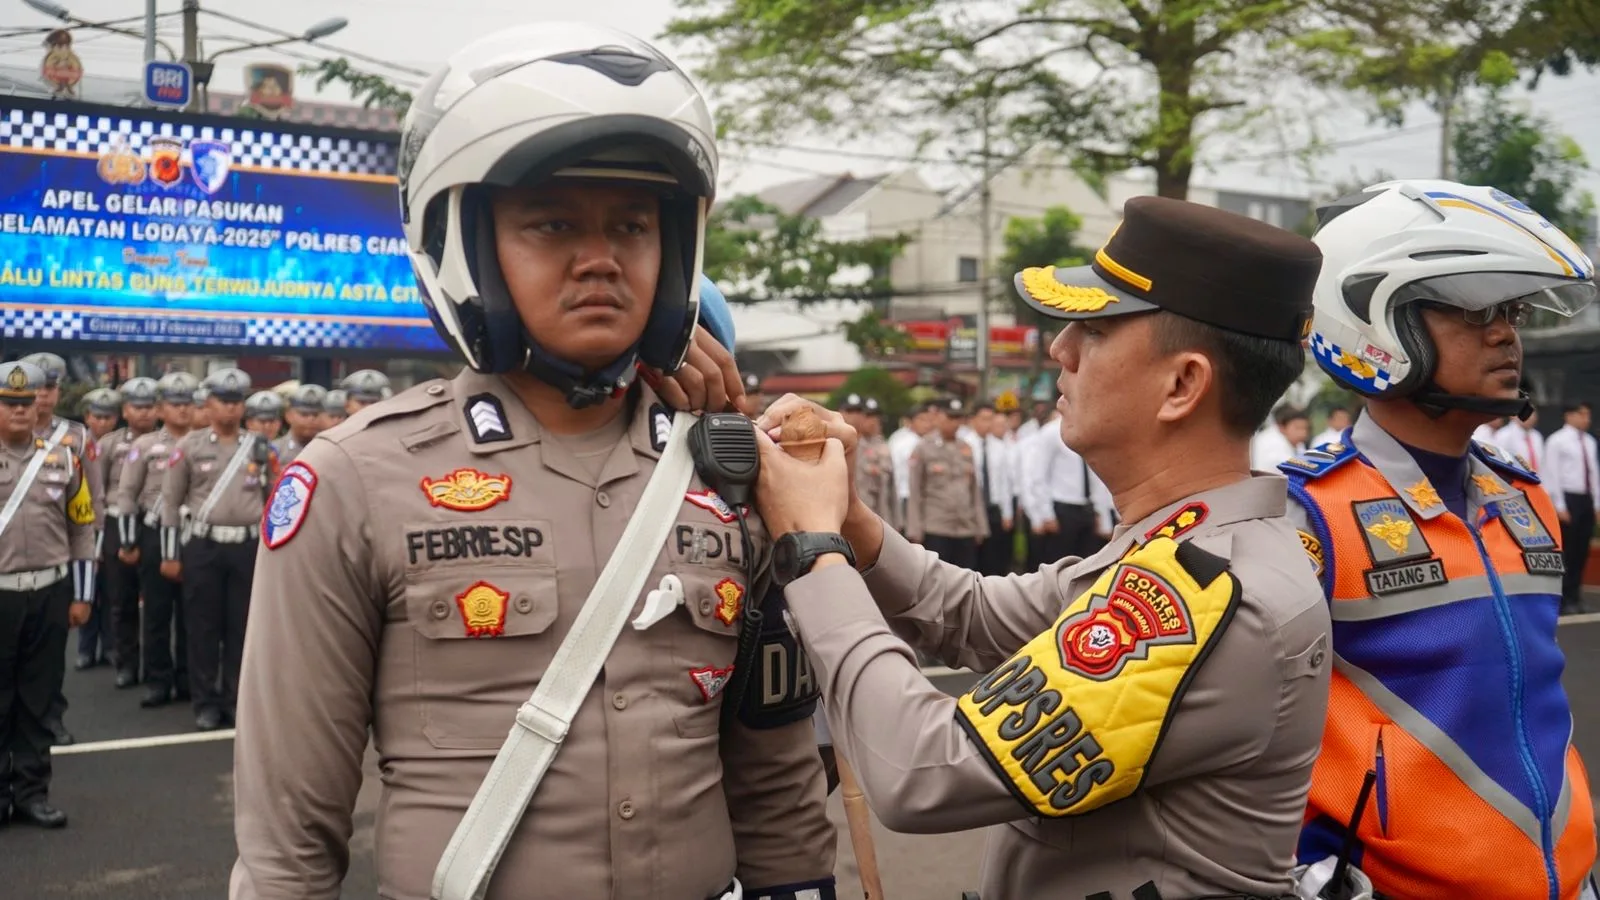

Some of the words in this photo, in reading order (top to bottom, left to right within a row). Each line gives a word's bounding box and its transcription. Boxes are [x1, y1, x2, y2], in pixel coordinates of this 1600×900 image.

[152, 68, 183, 88] BRI
[42, 189, 100, 211] APEL
[106, 194, 178, 216] GELAR
[184, 199, 284, 223] PASUKAN
[0, 213, 125, 239] ELAMATAN
[286, 231, 363, 254] POLRES
[50, 270, 124, 290] LINTAS
[130, 274, 188, 293] GUNA
[192, 277, 335, 301] TERWUJUDNYA
[340, 283, 388, 301] ASTA
[391, 286, 422, 303] CIT
[676, 525, 747, 567] POL
[1372, 566, 1425, 590] TATANG
[1430, 564, 1440, 580] R
[1113, 598, 1135, 612] JAWA
[1134, 610, 1151, 634] BARAT
[1124, 572, 1181, 629] POLRES
[1125, 582, 1171, 630] CIANJUR
